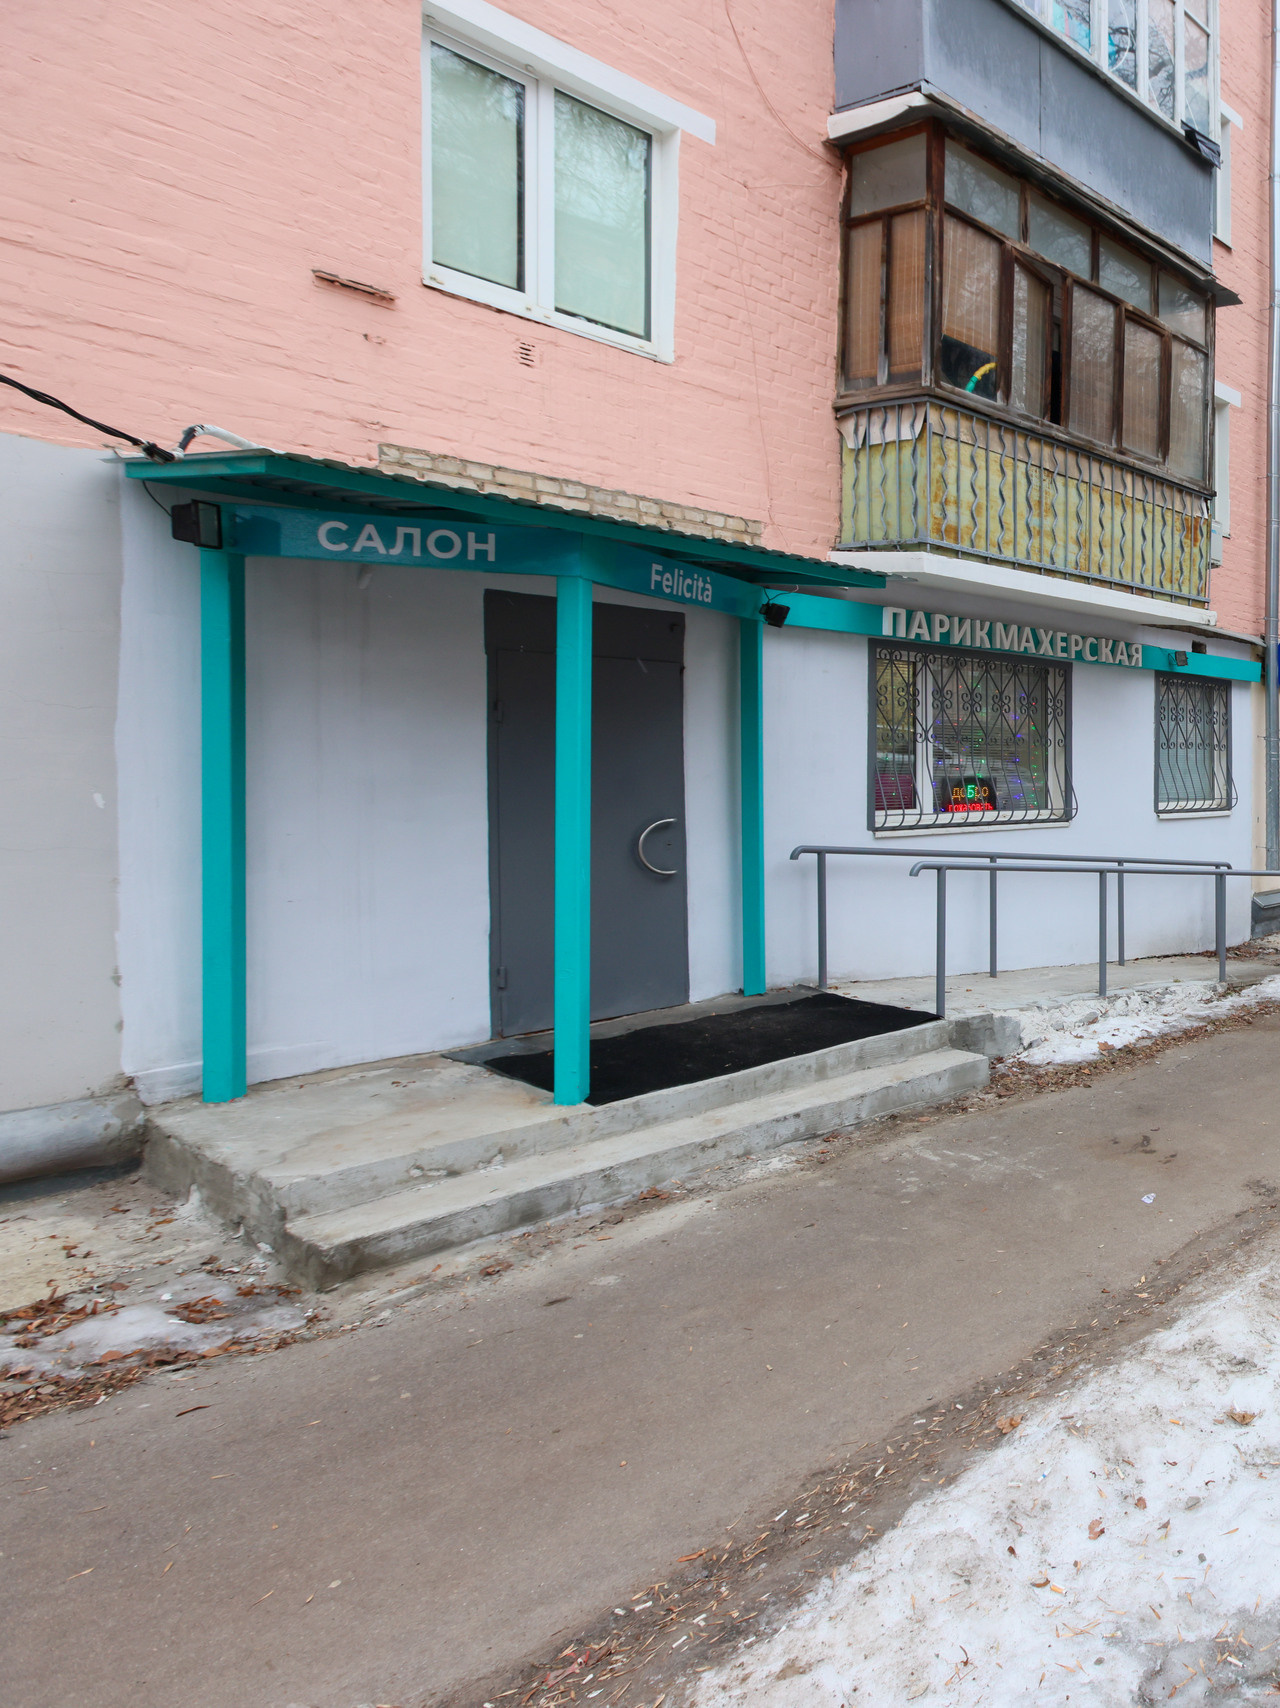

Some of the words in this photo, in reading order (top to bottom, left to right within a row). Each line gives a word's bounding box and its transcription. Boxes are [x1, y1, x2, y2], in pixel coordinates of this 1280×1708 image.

[317, 520, 496, 562] САЛОН
[651, 563, 712, 603] Felicità
[882, 606, 1143, 668] ПАРИКМАХЕРСКАЯ
